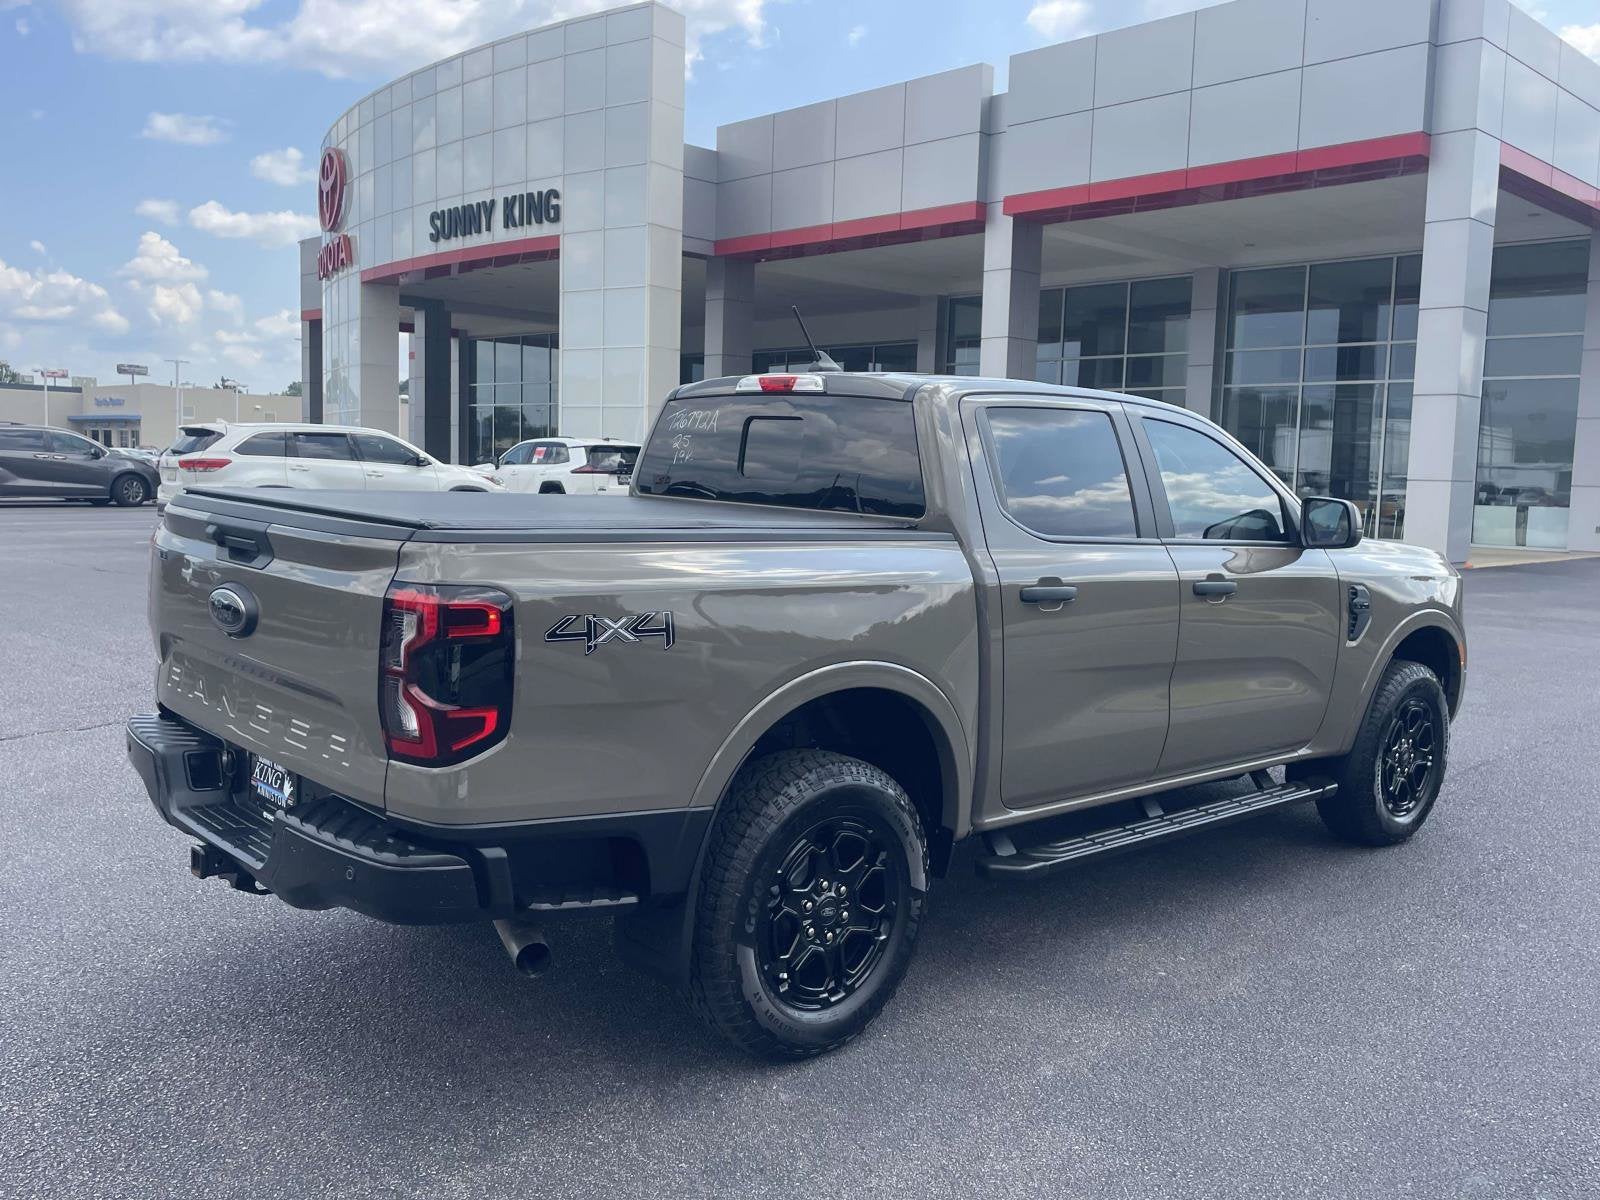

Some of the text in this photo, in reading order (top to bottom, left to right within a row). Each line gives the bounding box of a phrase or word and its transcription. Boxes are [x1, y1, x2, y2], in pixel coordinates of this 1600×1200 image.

[429, 188, 561, 243] SUNNY KING
[317, 234, 352, 280] TOYOTA
[166, 665, 350, 768] RANGER
[253, 761, 282, 788] KING
[256, 785, 287, 808] ANNISTON
